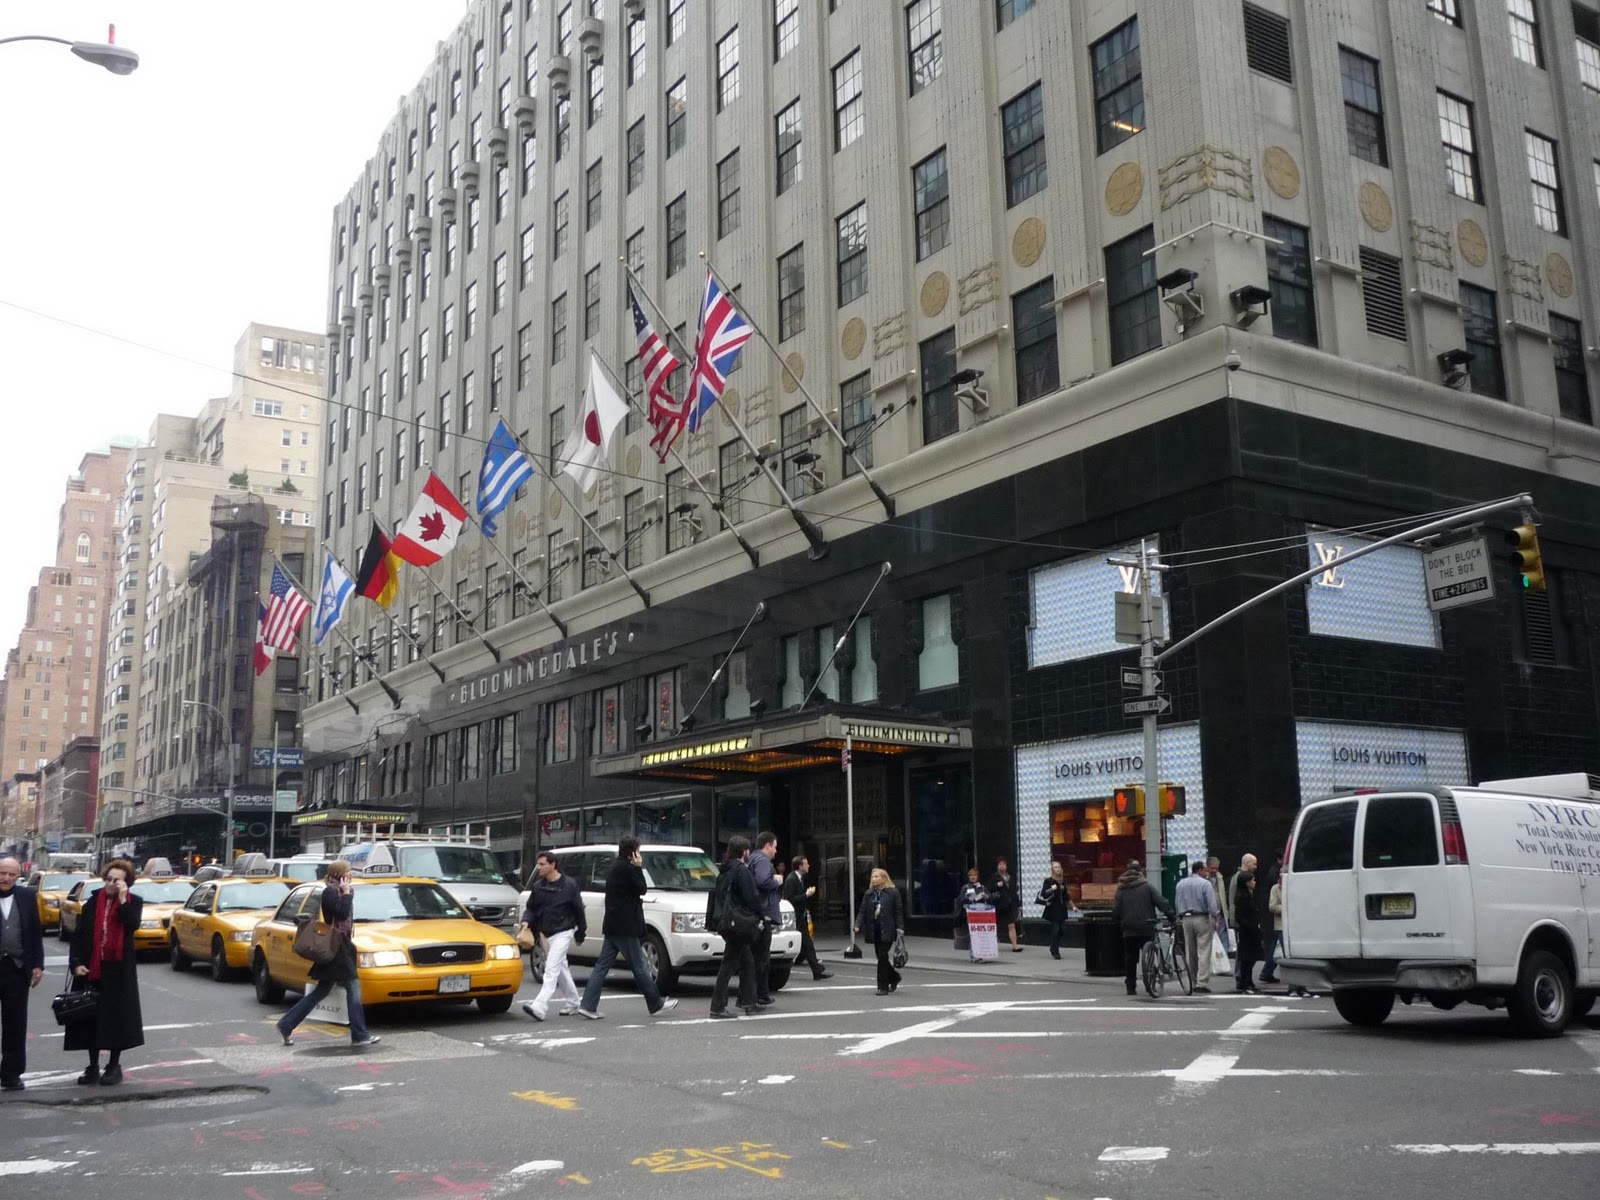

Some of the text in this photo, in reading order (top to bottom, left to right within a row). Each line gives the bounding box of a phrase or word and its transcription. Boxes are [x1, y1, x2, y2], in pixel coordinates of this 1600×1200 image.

[1428, 548, 1482, 570] DON'T BLOCK
[1439, 563, 1475, 580] THE BOX
[460, 631, 618, 704] BLOOMINGDALE'S
[1127, 674, 1140, 683] ONE
[1125, 699, 1162, 712] ONE WAY
[1334, 747, 1427, 766] LOUIS VUITTON
[1055, 756, 1143, 778] LOUIS VUITTO
[1551, 826, 1578, 840] Sushi
[1515, 838, 1538, 853] New
[1539, 841, 1564, 856] York
[1565, 843, 1587, 858] Rice
[1550, 859, 1575, 874] (718)
[987, 924, 996, 932] OFF
